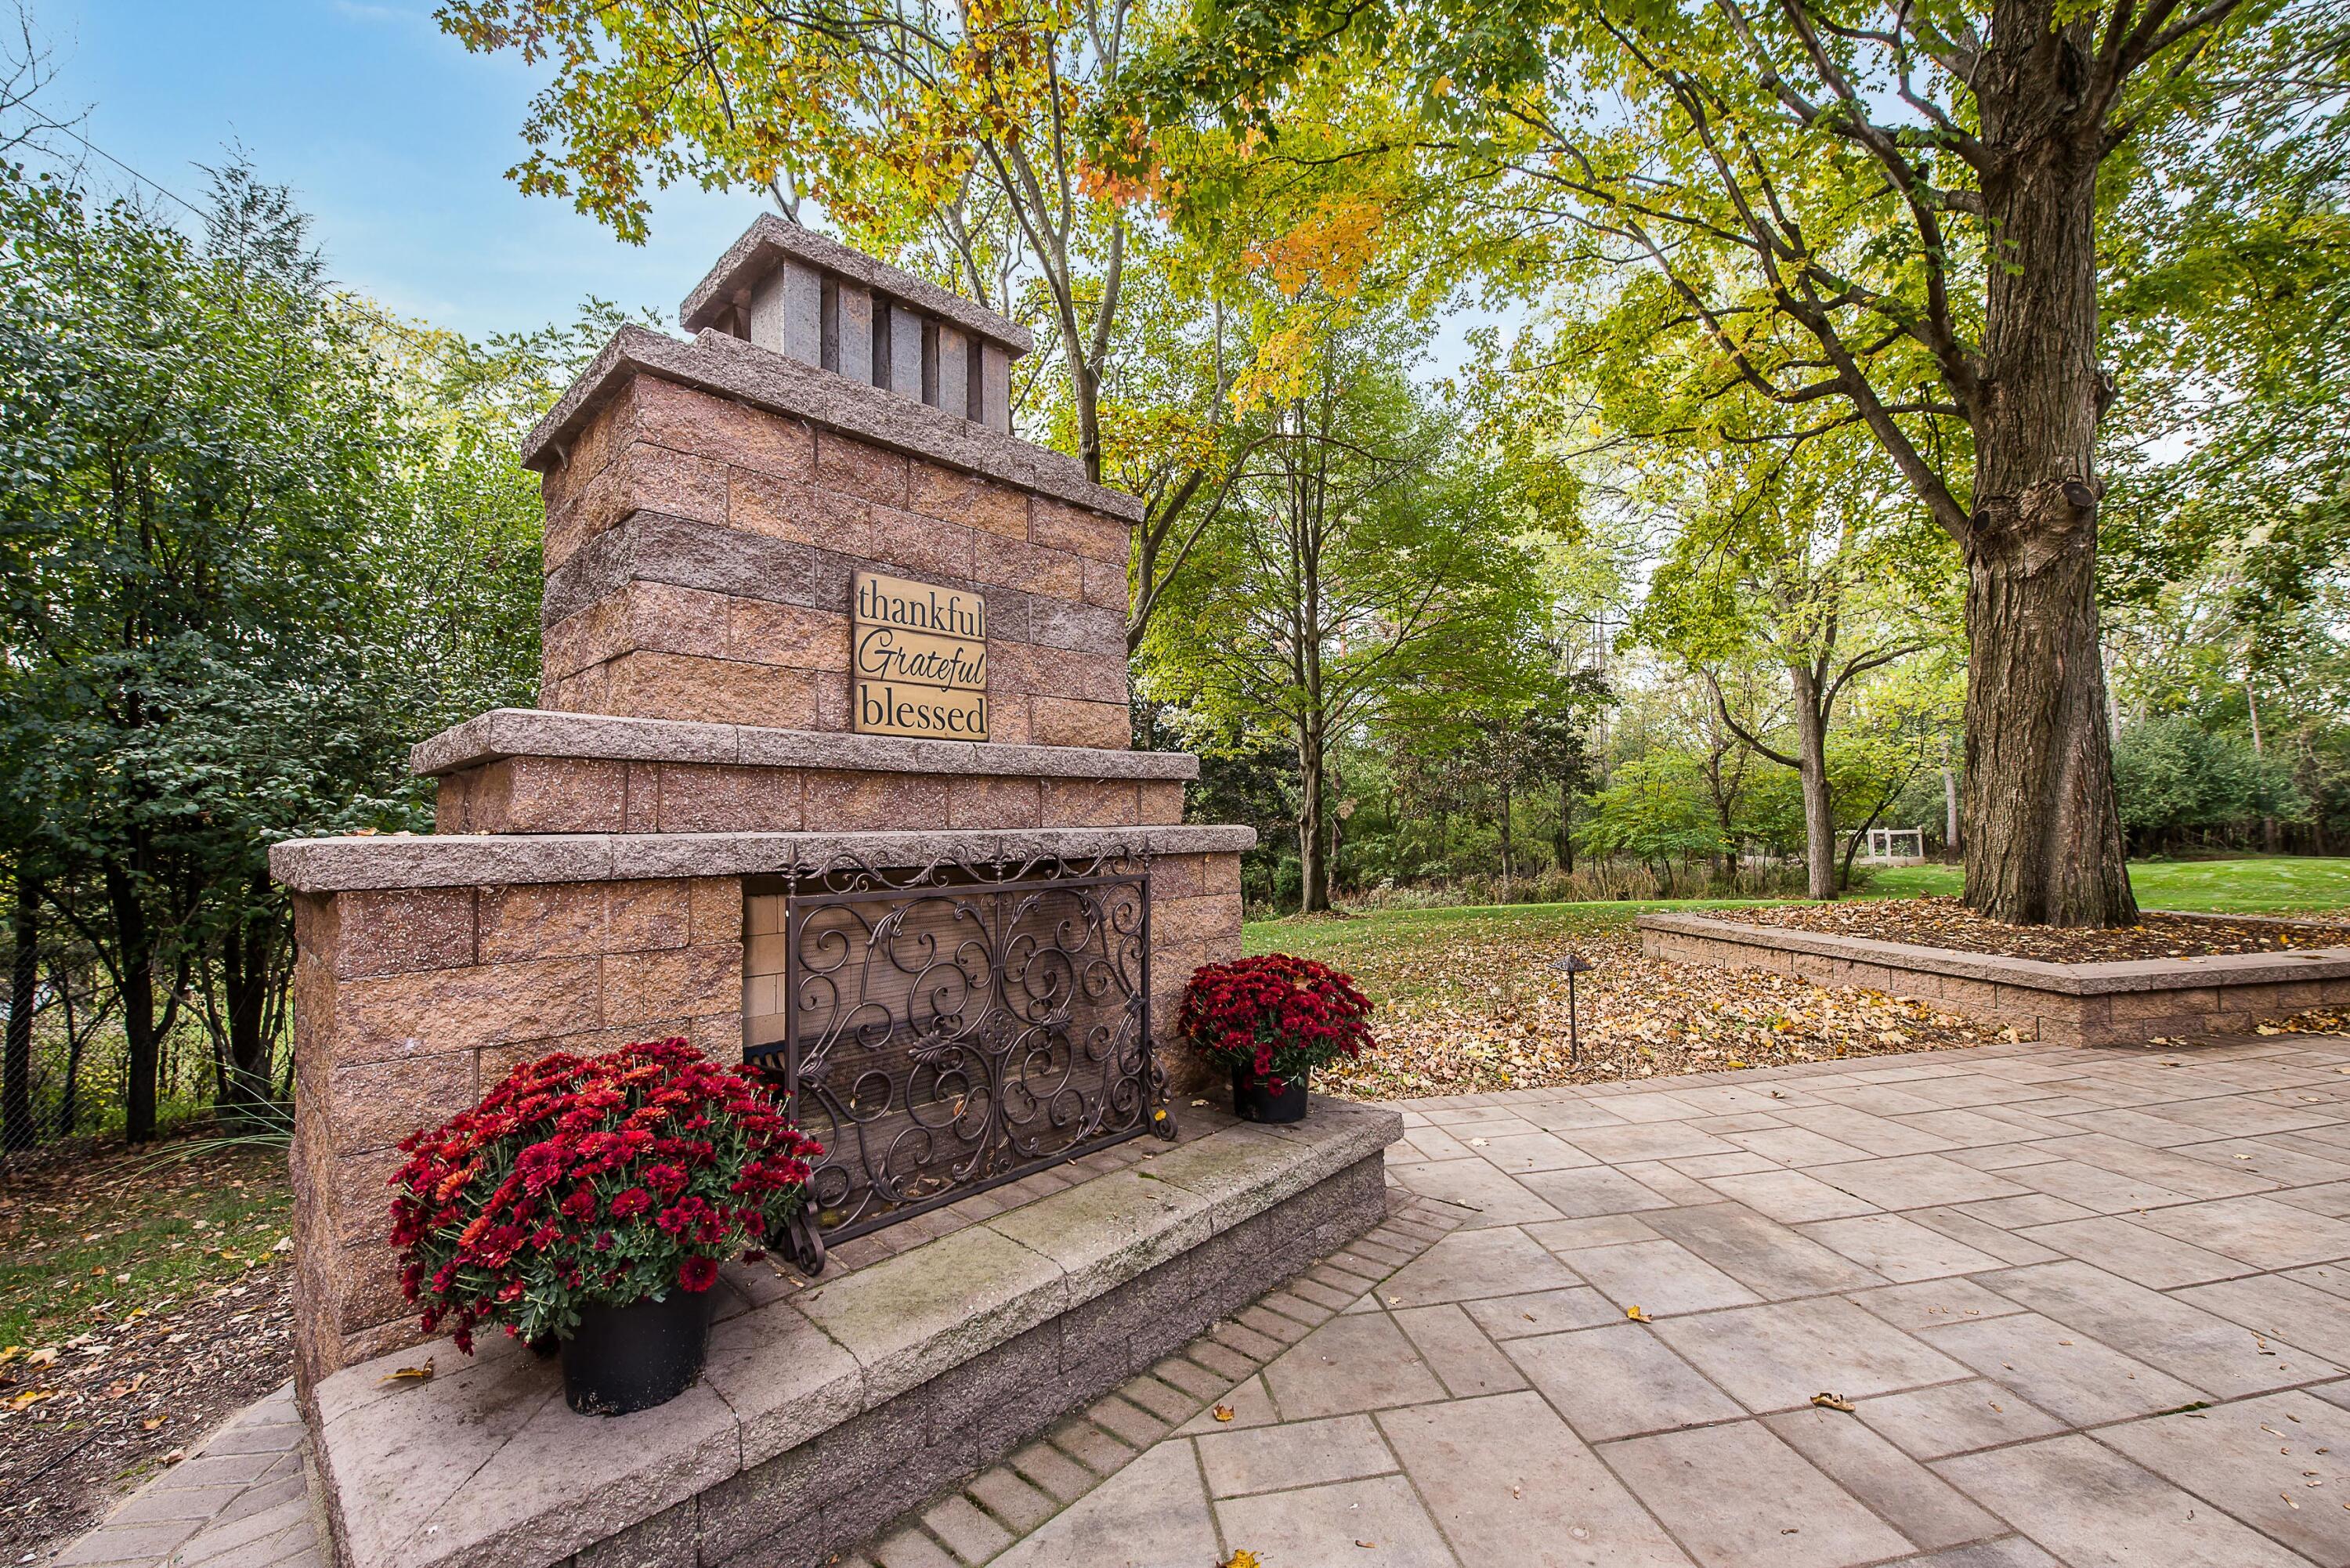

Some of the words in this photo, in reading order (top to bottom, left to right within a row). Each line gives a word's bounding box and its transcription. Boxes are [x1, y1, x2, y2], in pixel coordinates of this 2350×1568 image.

[859, 580, 985, 637] thankful
[859, 628, 985, 692] Grateful
[859, 685, 986, 733] blessed
